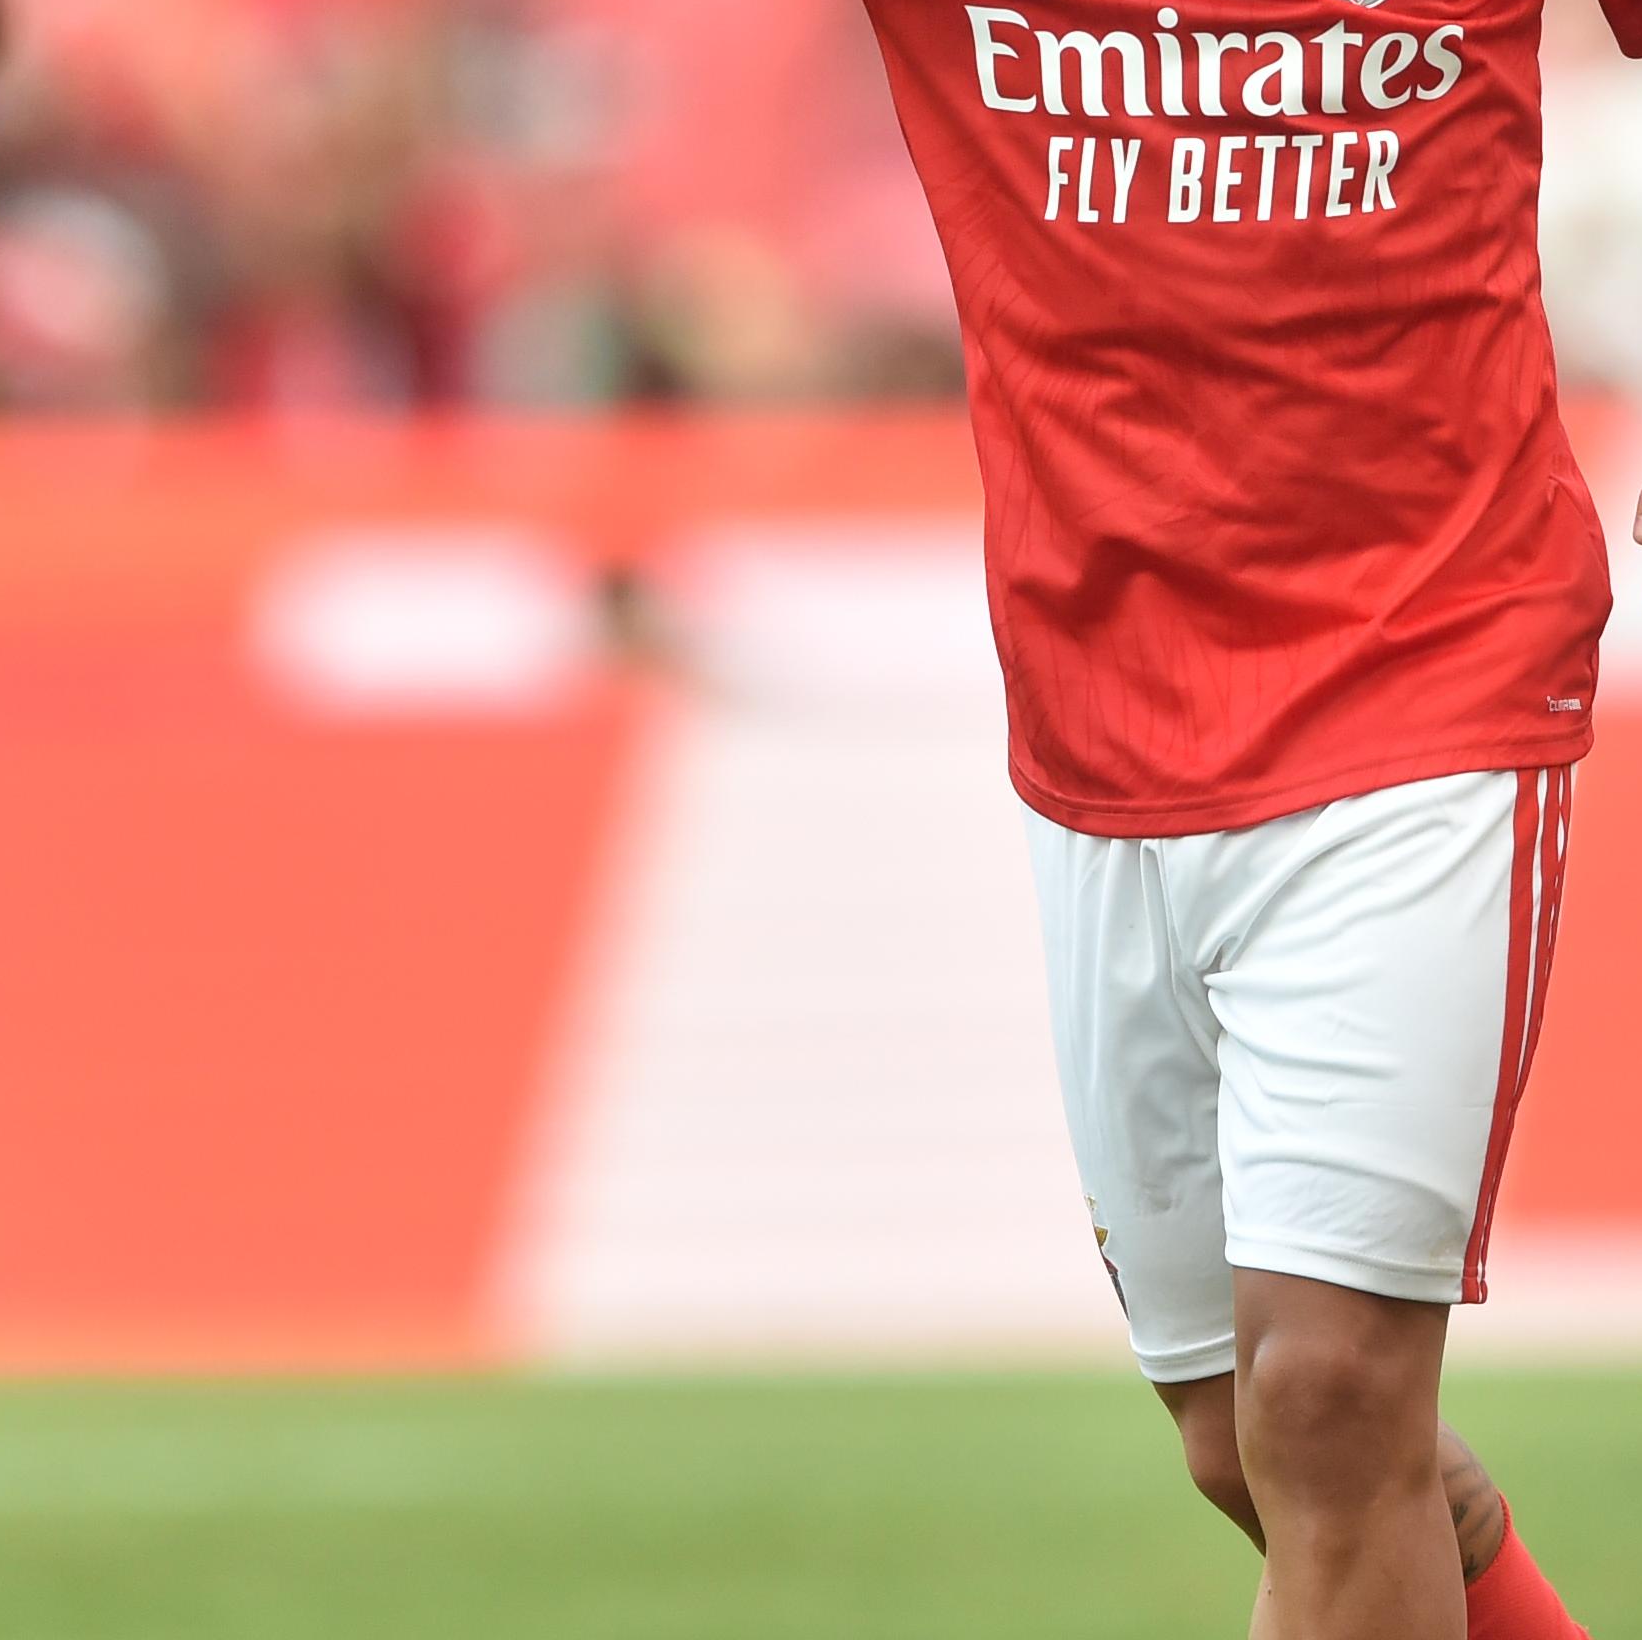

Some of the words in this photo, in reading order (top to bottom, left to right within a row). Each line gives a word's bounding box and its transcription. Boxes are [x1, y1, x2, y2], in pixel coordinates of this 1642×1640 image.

[964, 5, 1464, 117] Emirates
[1044, 136, 1142, 224] FLY
[1167, 129, 1400, 223] BETTER
